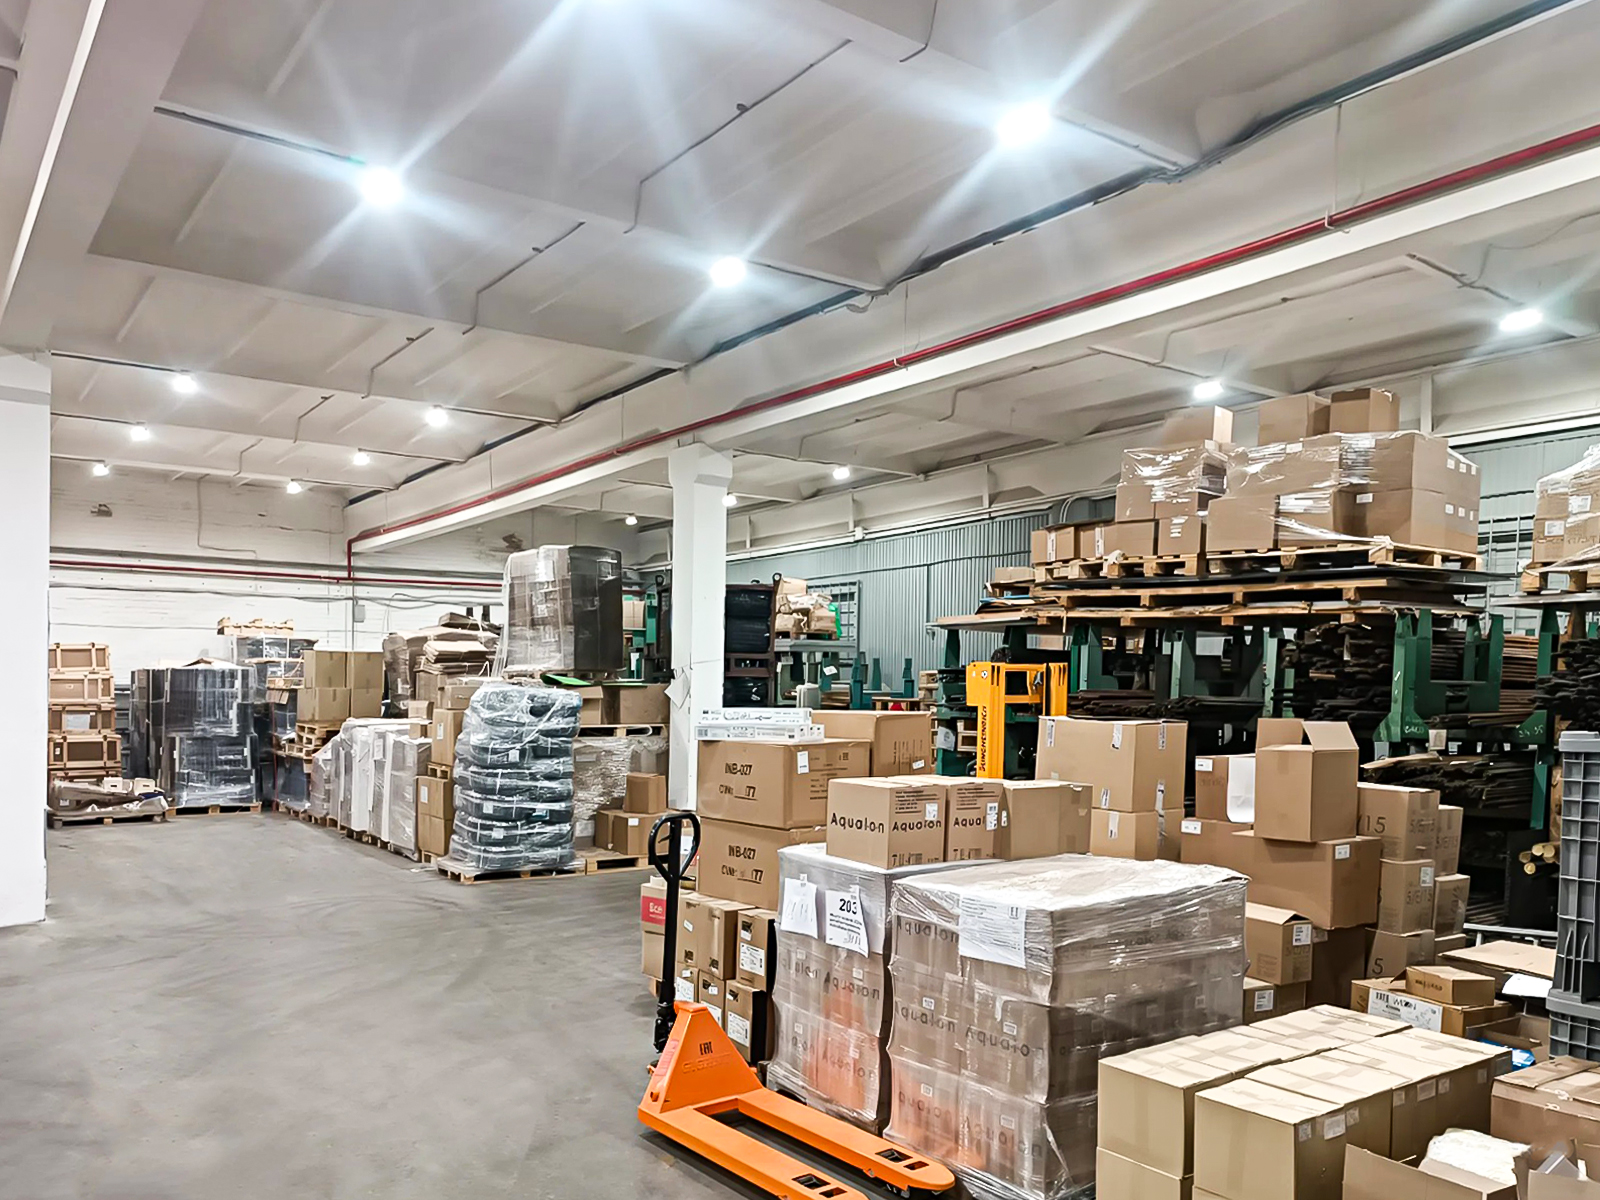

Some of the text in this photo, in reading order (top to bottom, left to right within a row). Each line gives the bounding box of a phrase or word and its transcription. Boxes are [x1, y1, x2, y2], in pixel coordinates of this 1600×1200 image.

[830, 812, 885, 834] Aqualon
[892, 818, 942, 833] Aqualon
[839, 898, 857, 915] 203
[1371, 957, 1384, 975] 5
